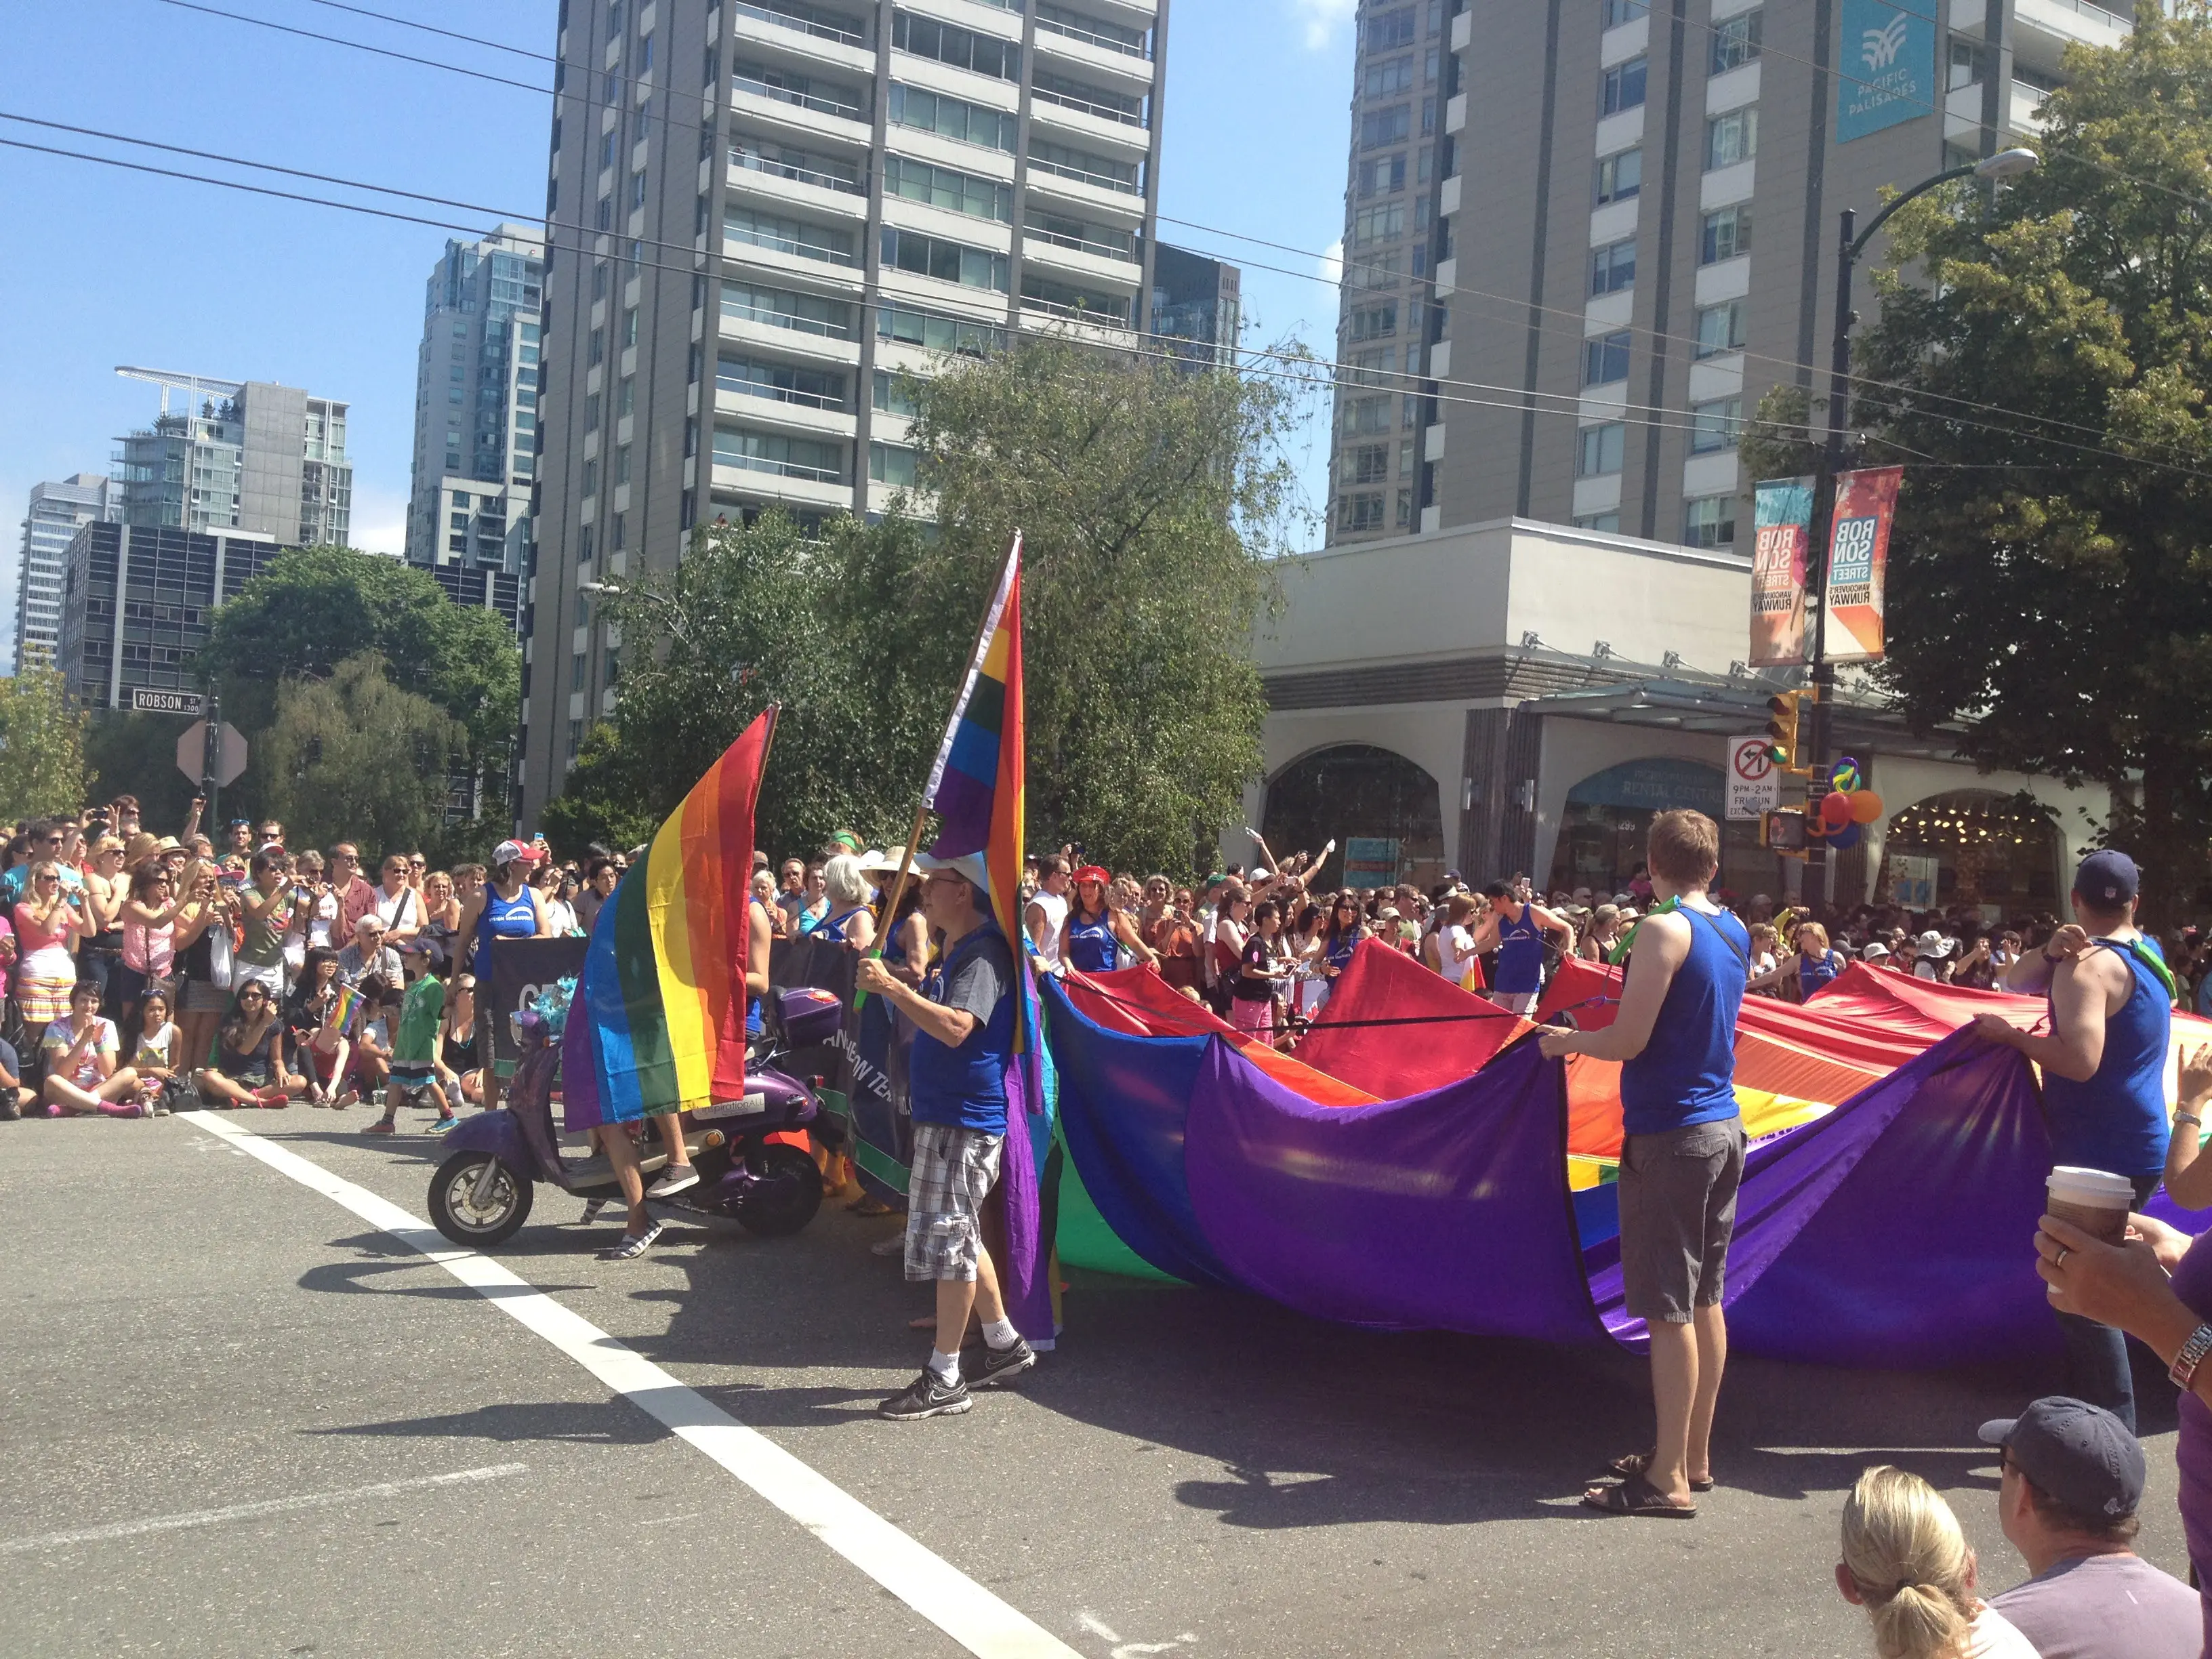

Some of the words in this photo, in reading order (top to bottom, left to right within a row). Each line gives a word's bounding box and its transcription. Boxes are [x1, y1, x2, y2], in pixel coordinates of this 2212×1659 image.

[1849, 80, 1917, 115] PALISADES
[1858, 68, 1907, 98] PACIFIC
[139, 693, 182, 710] ROBSON
